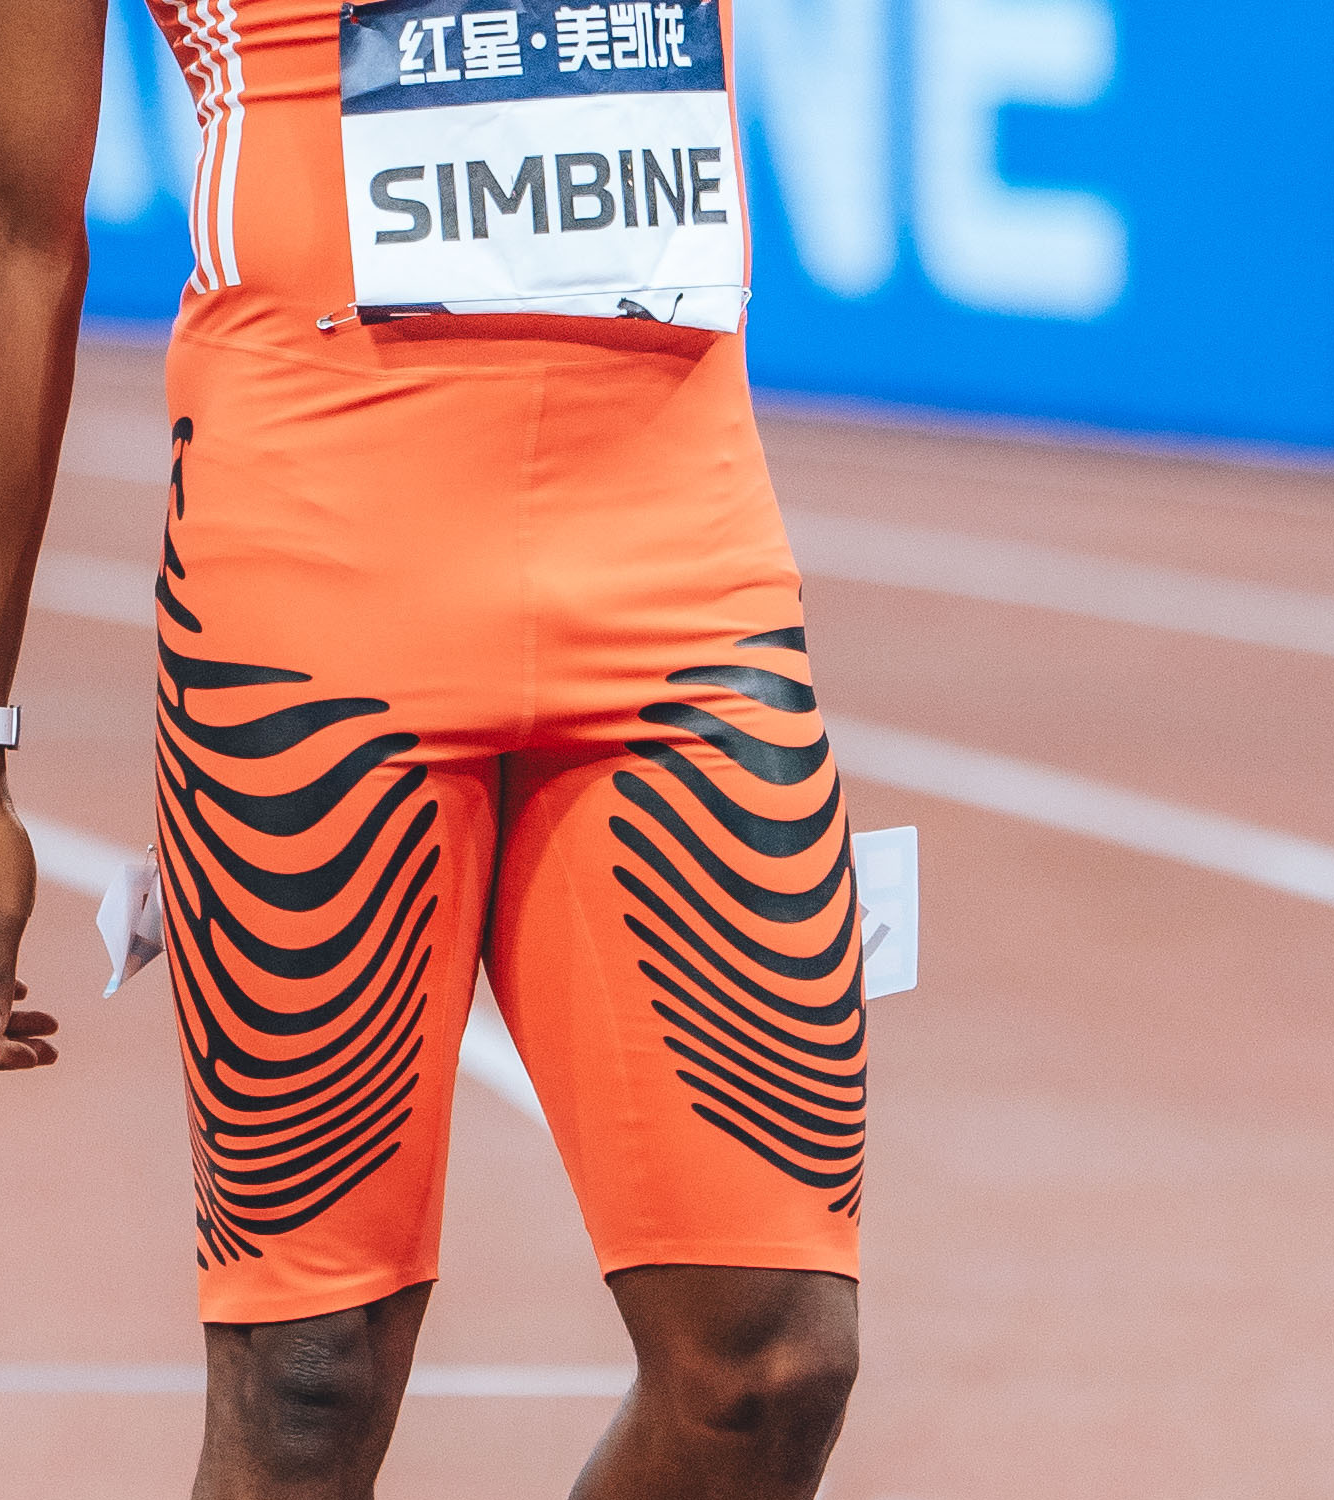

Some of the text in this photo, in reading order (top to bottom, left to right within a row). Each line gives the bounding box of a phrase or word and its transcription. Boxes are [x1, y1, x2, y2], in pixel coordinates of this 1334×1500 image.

[398, 1, 693, 86] 红星·美凯龙
[368, 146, 729, 246] SIMBINE
